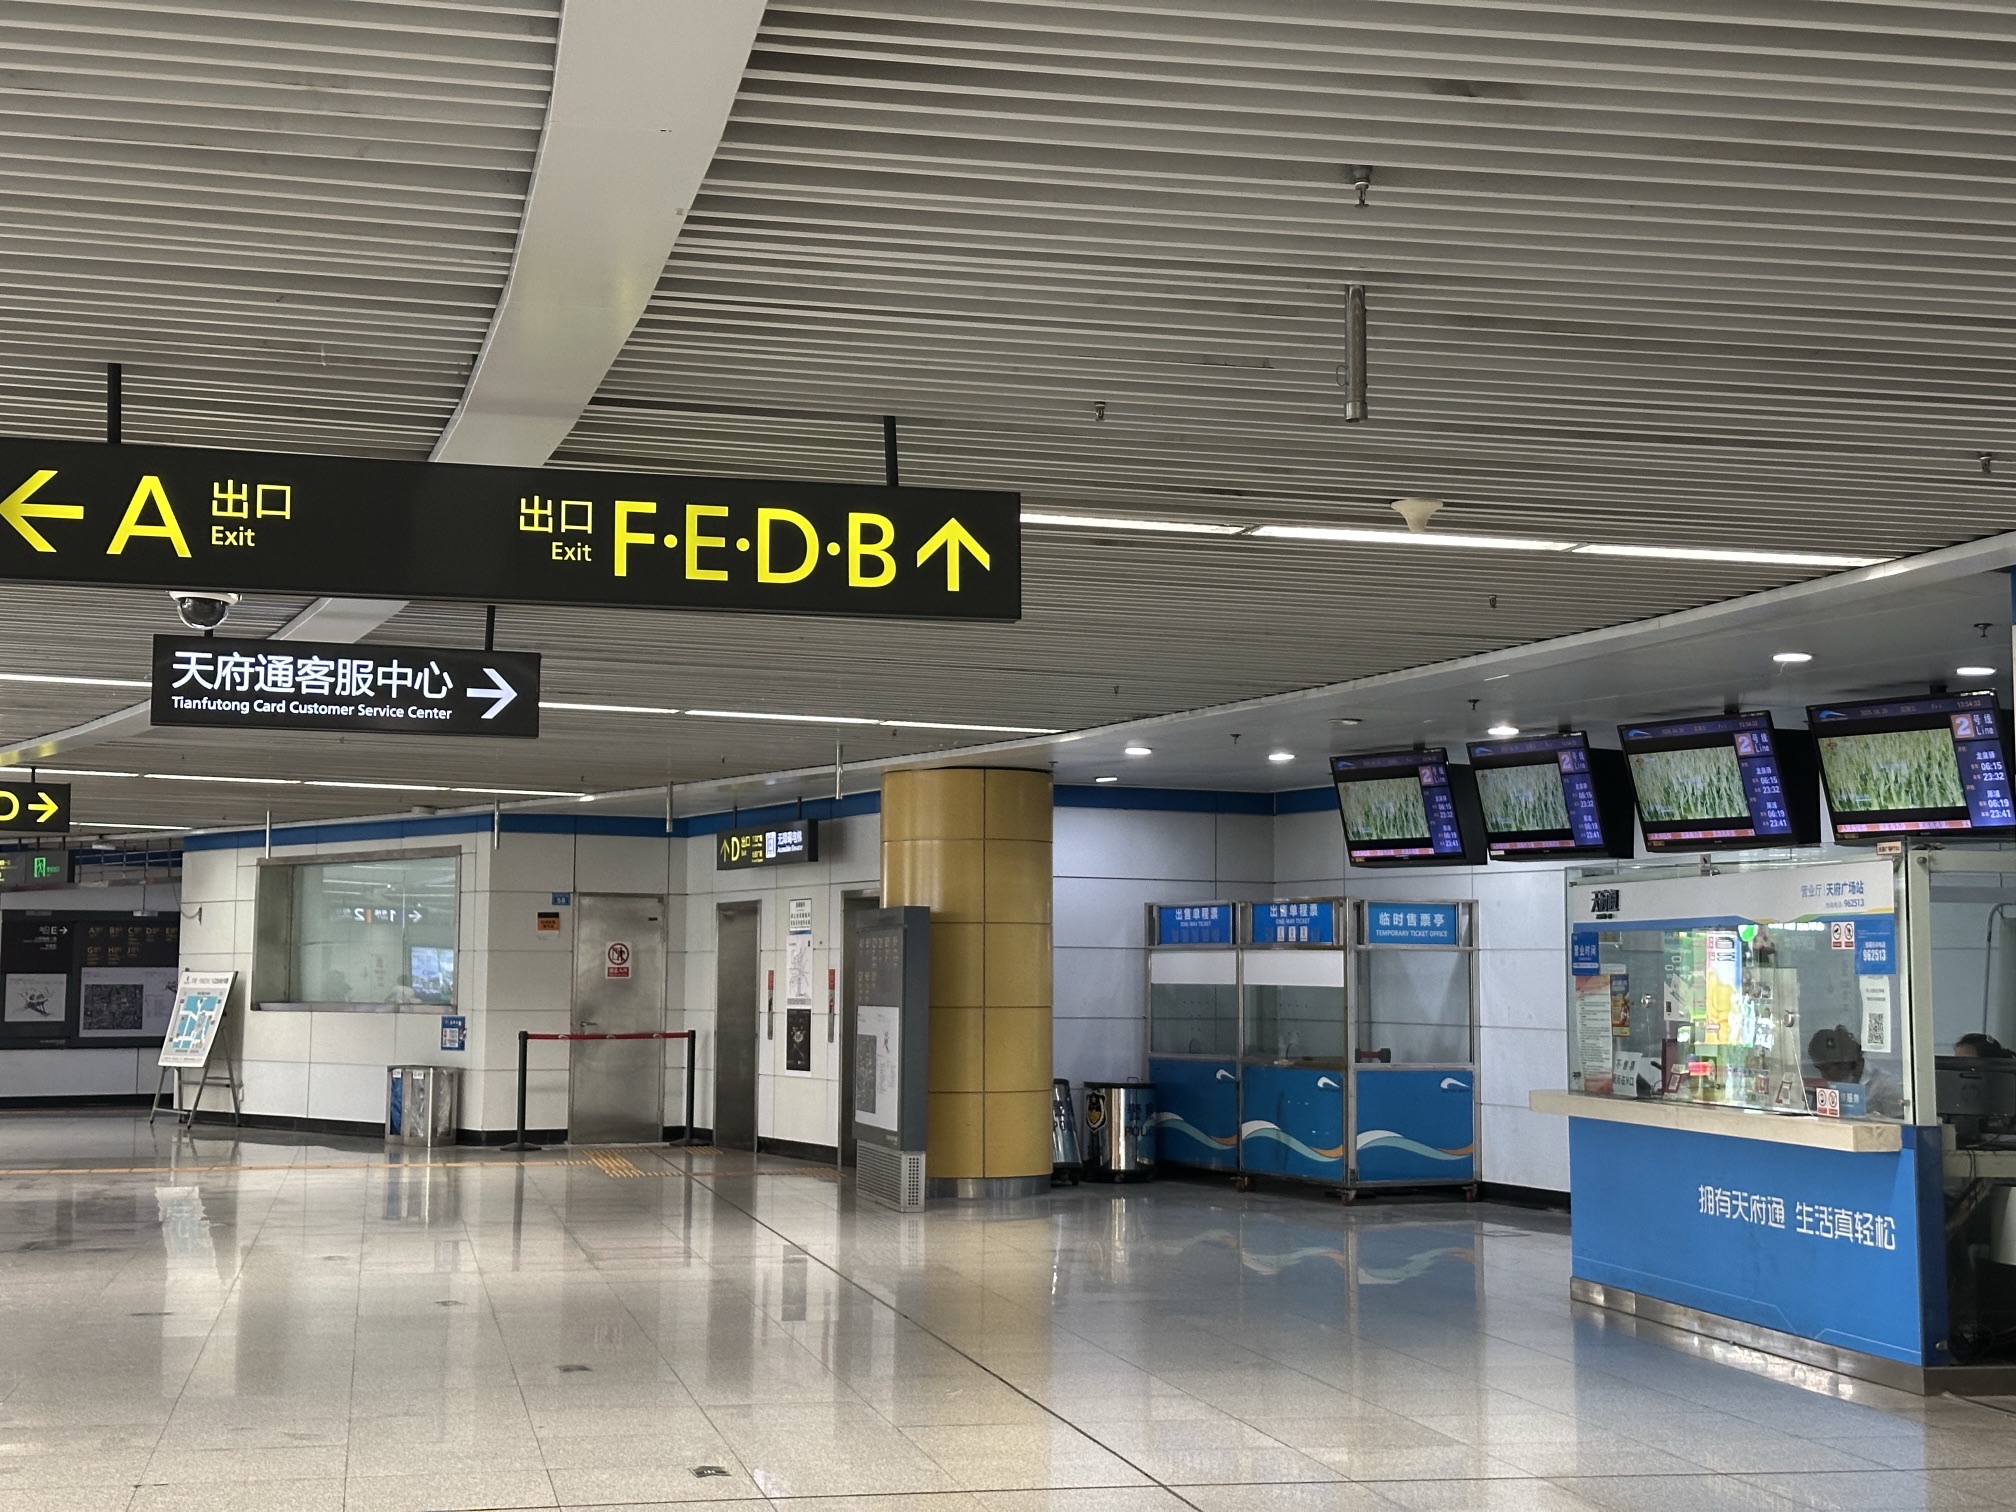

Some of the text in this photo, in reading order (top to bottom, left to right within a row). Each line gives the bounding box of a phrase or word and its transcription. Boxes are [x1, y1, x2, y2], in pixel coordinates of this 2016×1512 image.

[211, 479, 291, 520] 出口
[107, 476, 192, 557] A
[519, 495, 593, 534] 出口
[211, 526, 256, 547] Exit
[551, 541, 592, 562] Exit
[172, 651, 453, 699] 天府通客服中心
[172, 695, 453, 720] Tianfutong Card Customer Service Center
[1955, 716, 1971, 735] 2
[1976, 726, 1994, 735] Line
[1738, 736, 1752, 752] 2
[1755, 744, 1770, 752] Line
[1561, 754, 1571, 769] 2
[1981, 762, 2003, 771] 06:15
[1421, 768, 1431, 783] 2
[1760, 776, 1778, 785] 06:15
[1983, 772, 2005, 781] 23:32
[1763, 786, 1781, 794] 23:32
[1988, 799, 2010, 808] 06:19
[1768, 810, 1785, 818] 06:19
[1990, 809, 2012, 818] 23:41
[1770, 819, 1787, 828] 23:41
[731, 836, 741, 862] D
[1801, 880, 1864, 898] 营业厅 天府广场站
[1270, 903, 1318, 917] 出售单程票
[1844, 899, 1865, 908] 962513
[1175, 907, 1218, 920] 出售单程票
[1379, 912, 1444, 927] 临时售票亭
[1376, 929, 1409, 937] TEMPORARY
[1429, 930, 1448, 938] OFFICE
[1574, 945, 1597, 957] 营业时间
[1863, 949, 1886, 961] 962513
[1699, 1185, 1896, 1251] 拥有天府通 生活真轻松
